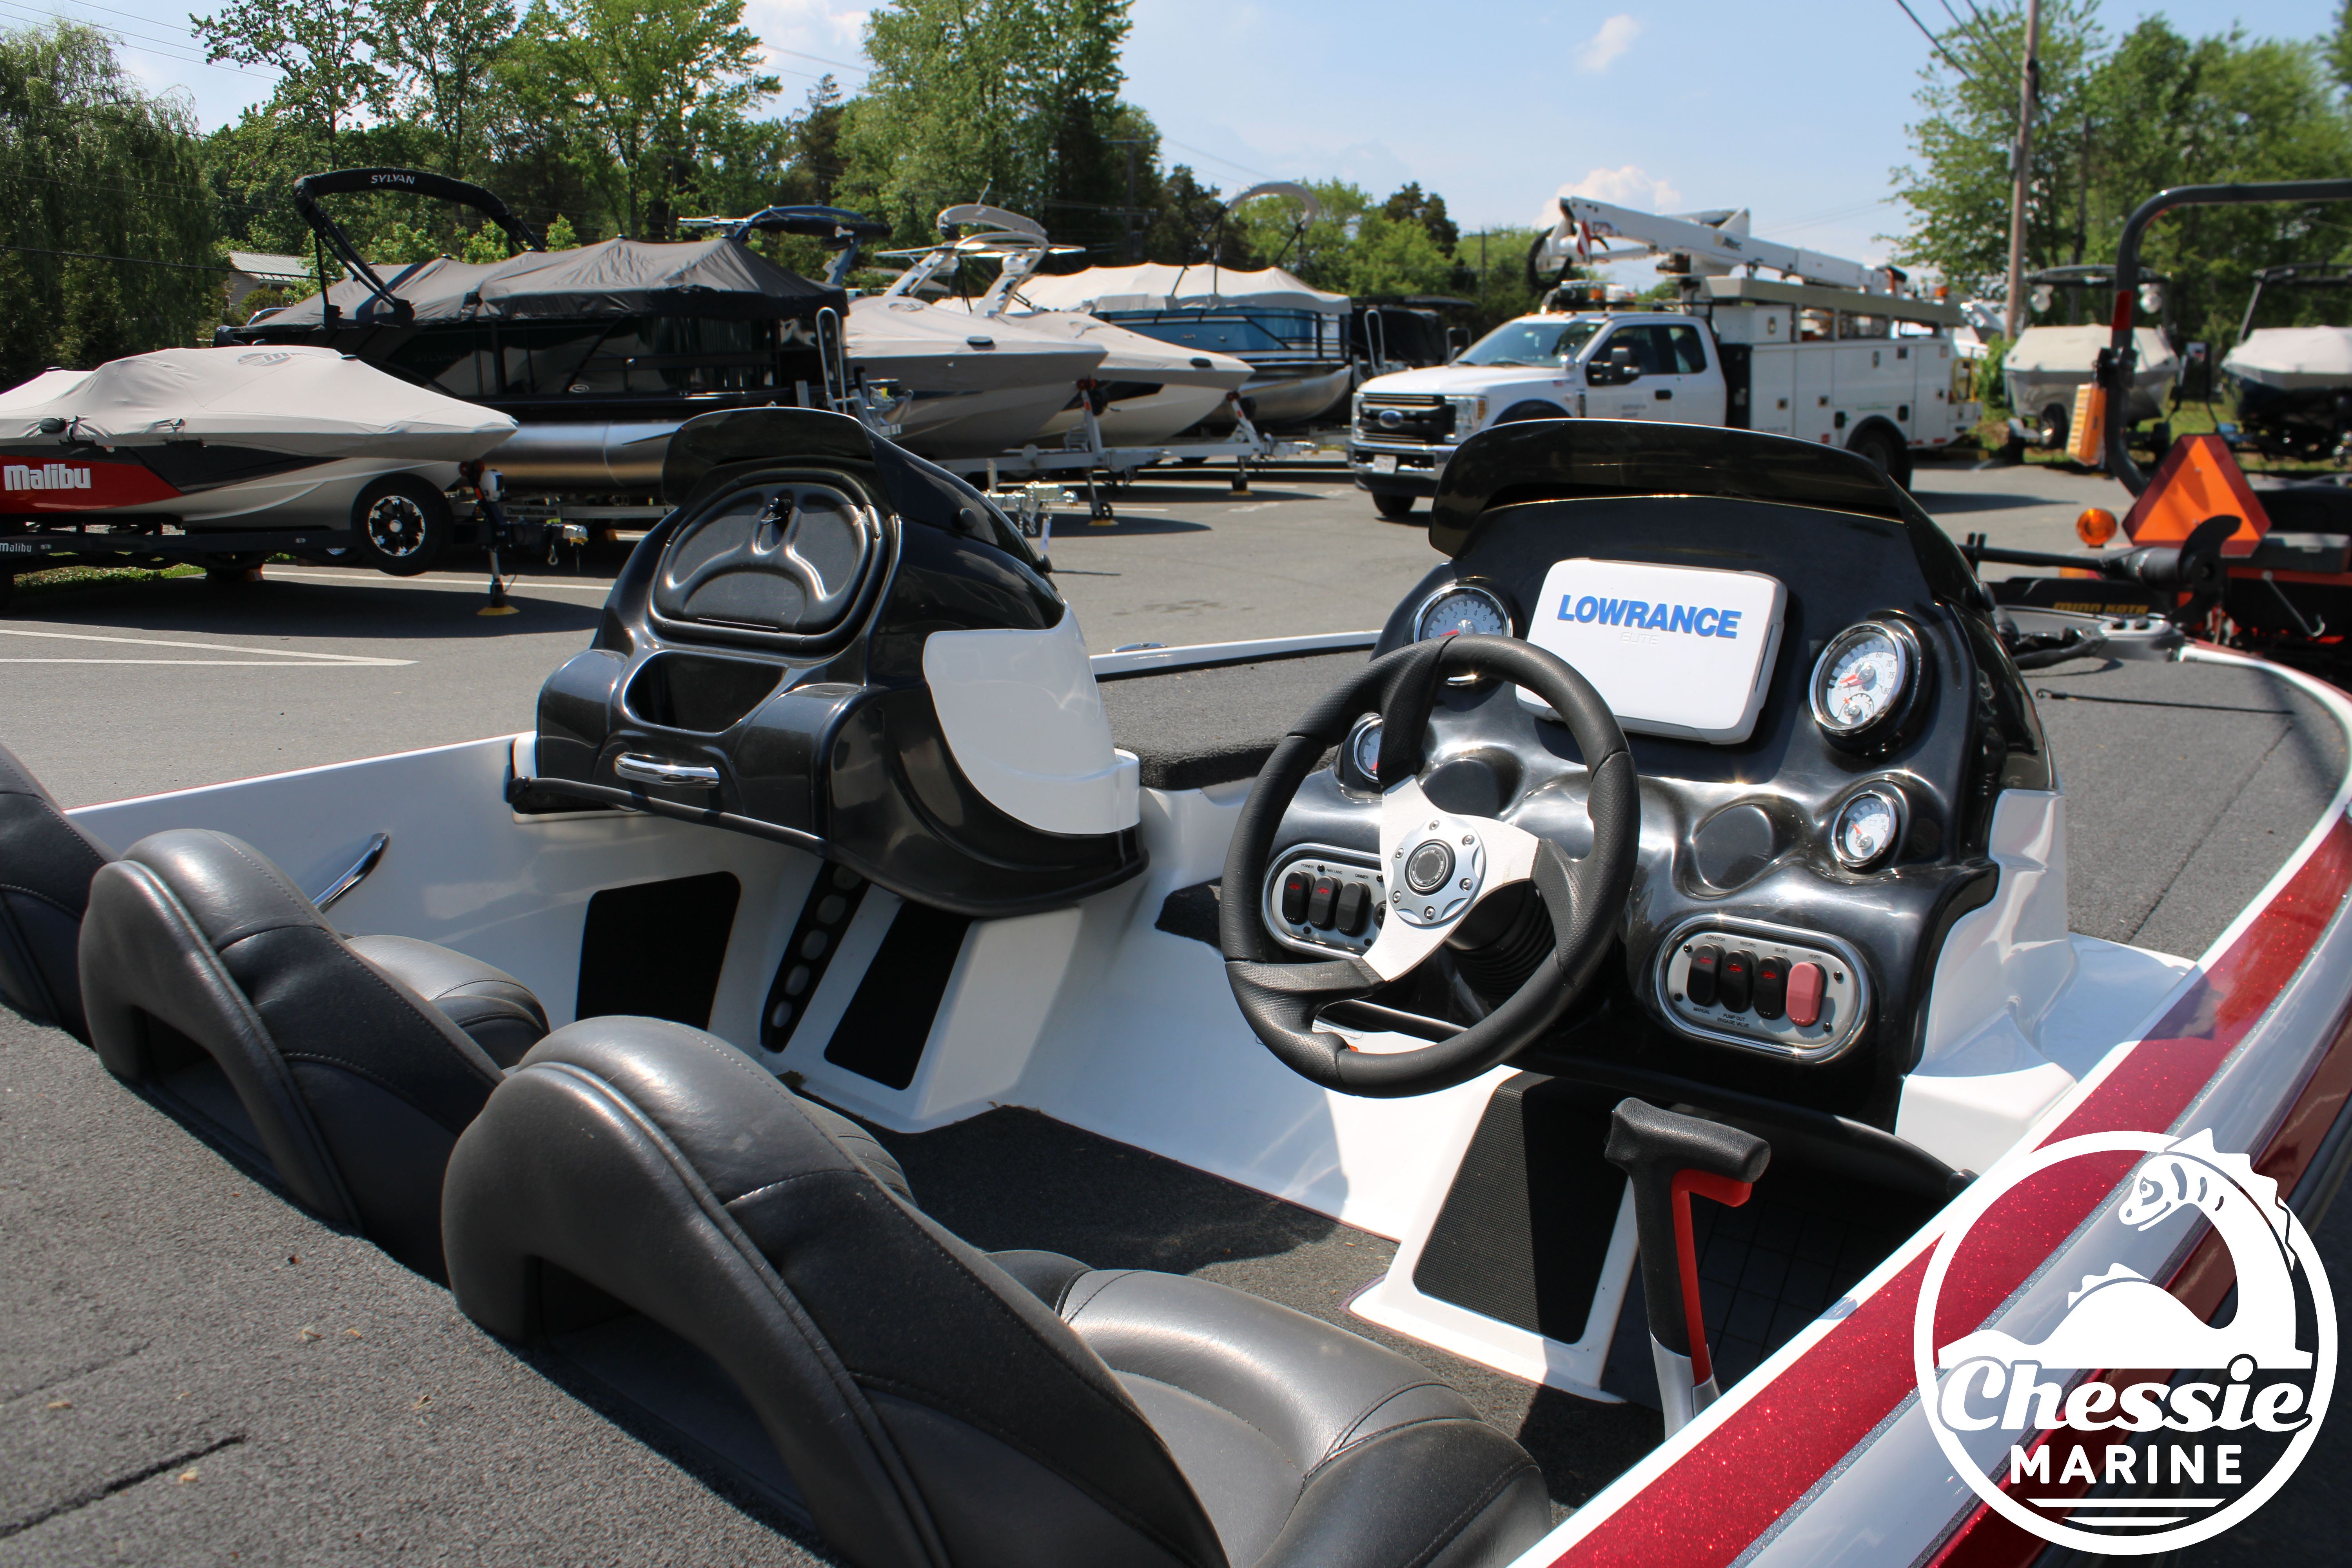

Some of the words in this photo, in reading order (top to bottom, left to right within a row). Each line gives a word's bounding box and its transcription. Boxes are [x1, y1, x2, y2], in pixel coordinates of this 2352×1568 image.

[371, 174, 415, 184] SYLVAN
[4, 464, 91, 491] Malibu
[0, 543, 32, 552] Malibu
[1557, 594, 1742, 639] LOWRANCE
[1620, 632, 1659, 646] ELITE
